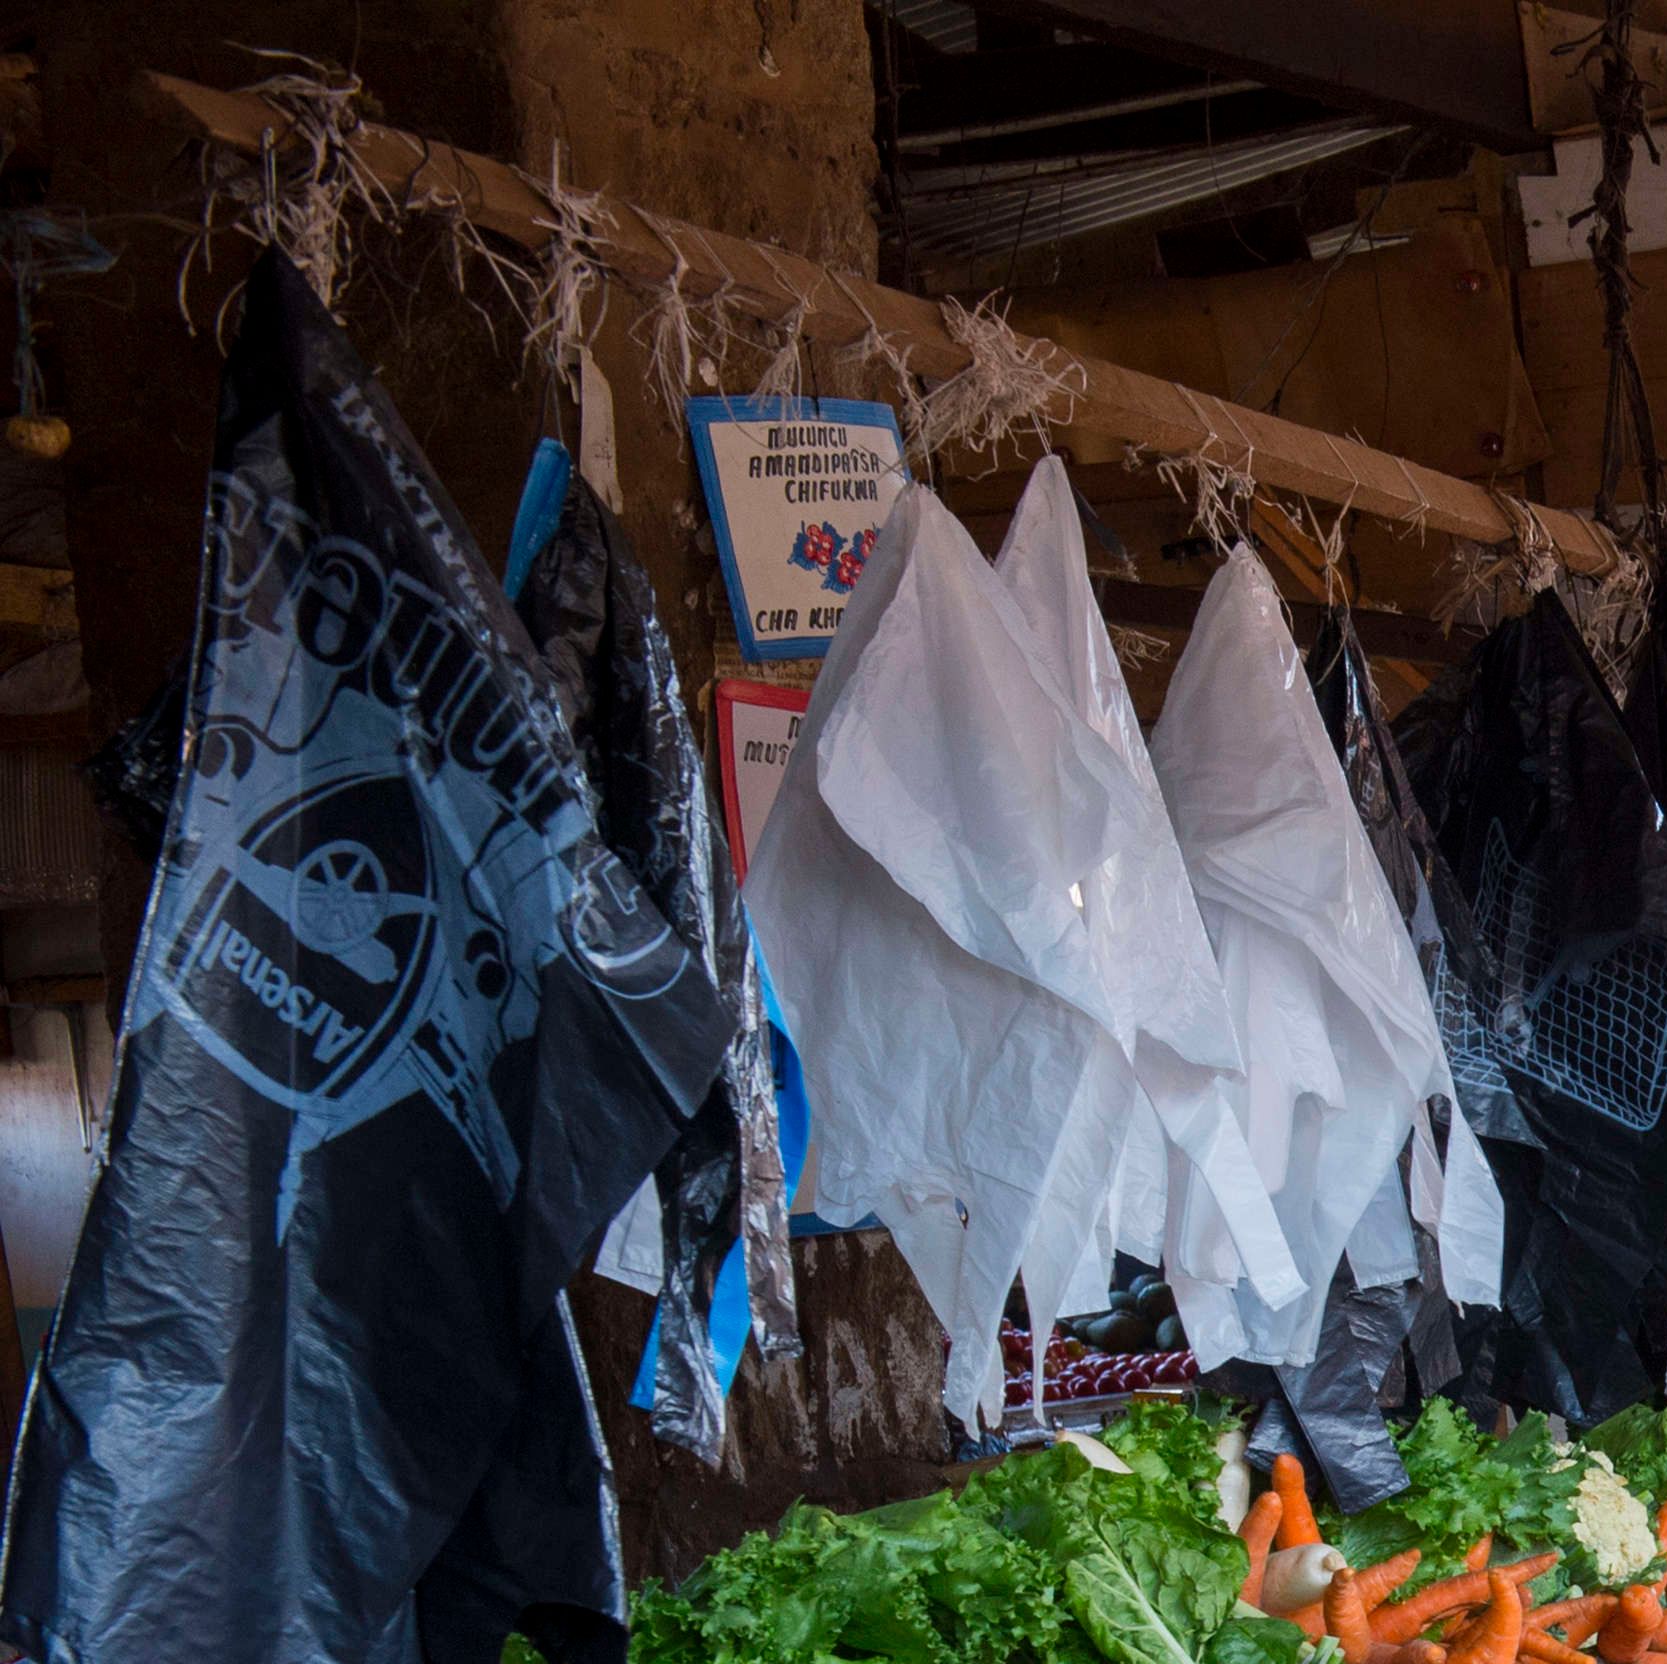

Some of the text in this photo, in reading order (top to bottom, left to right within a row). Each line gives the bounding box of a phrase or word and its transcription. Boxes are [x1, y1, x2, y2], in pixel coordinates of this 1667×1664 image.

[784, 478, 879, 503] CHIFUKWA
[755, 608, 799, 633] CHA
[199, 918, 367, 1066] Arsenal
